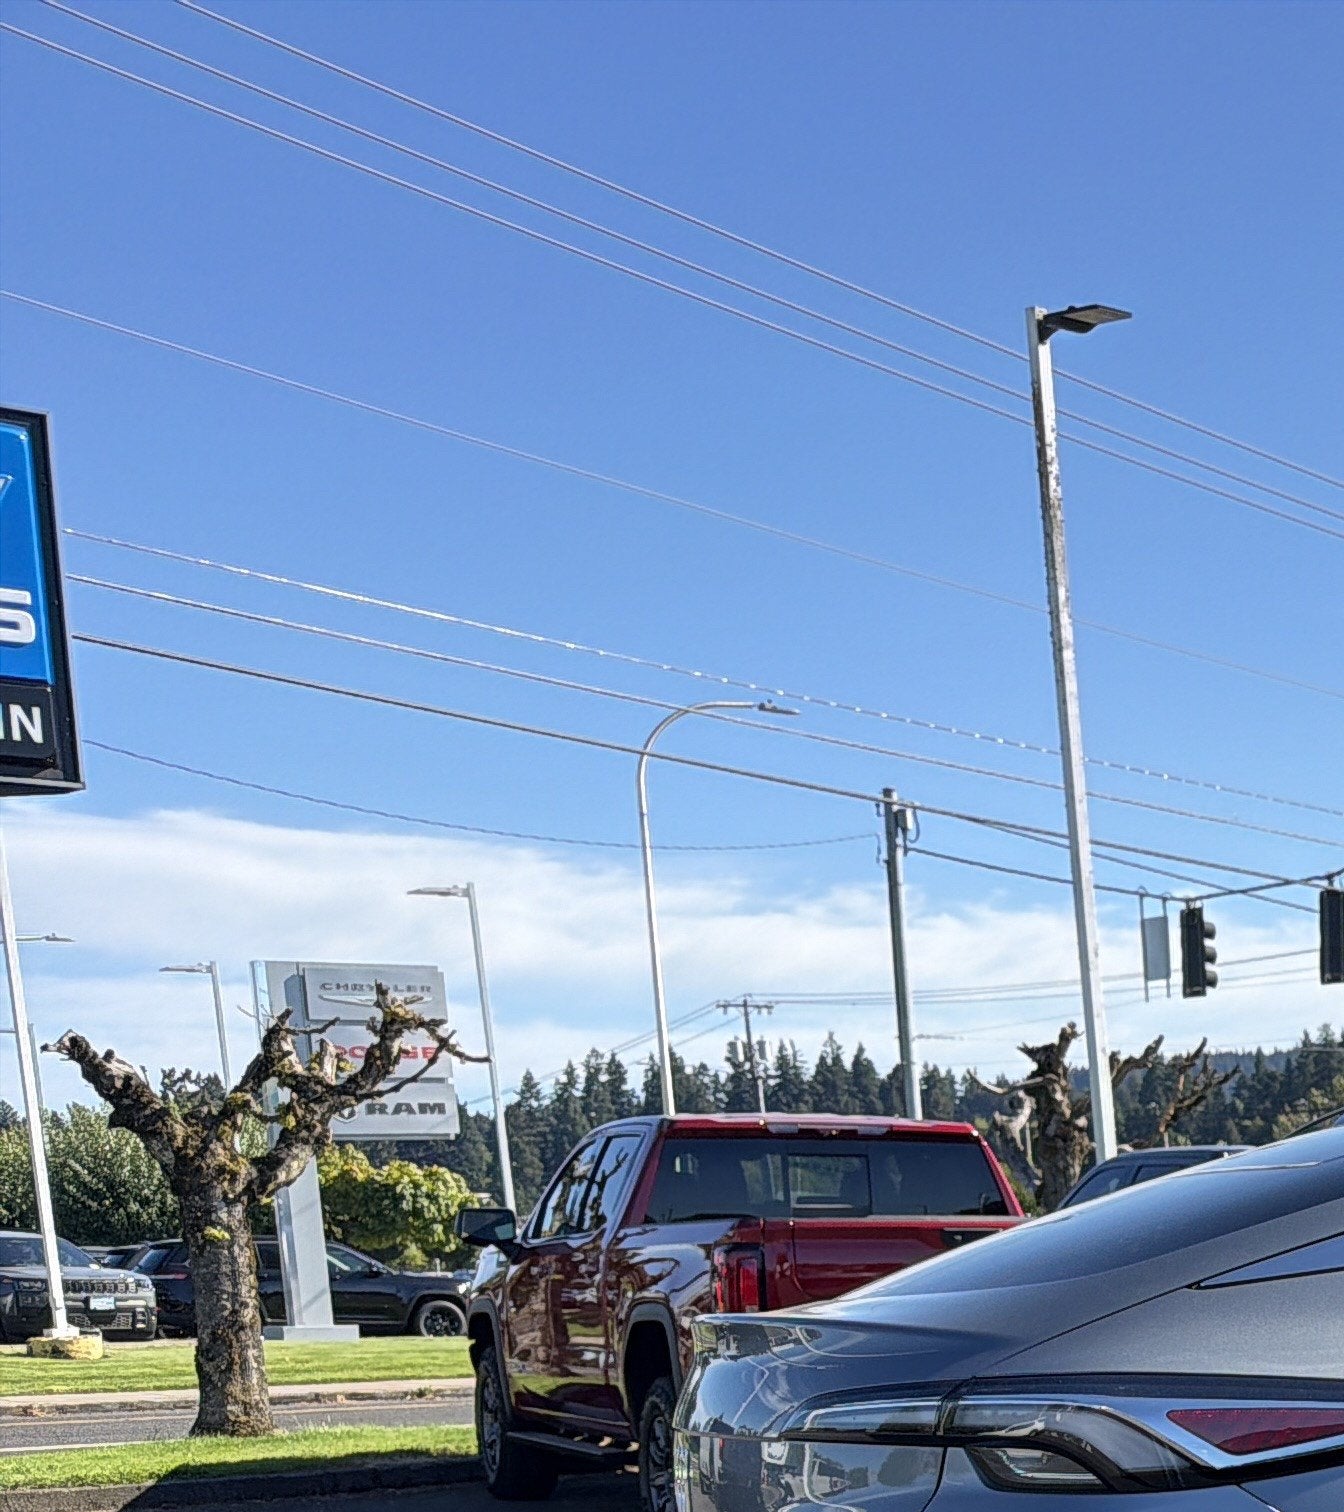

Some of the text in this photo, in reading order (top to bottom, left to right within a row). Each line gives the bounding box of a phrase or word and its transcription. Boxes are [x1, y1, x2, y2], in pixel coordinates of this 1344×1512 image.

[319, 982, 432, 992] CHRYLER
[334, 1045, 437, 1060] DOGE
[365, 1102, 447, 1116] RAM
